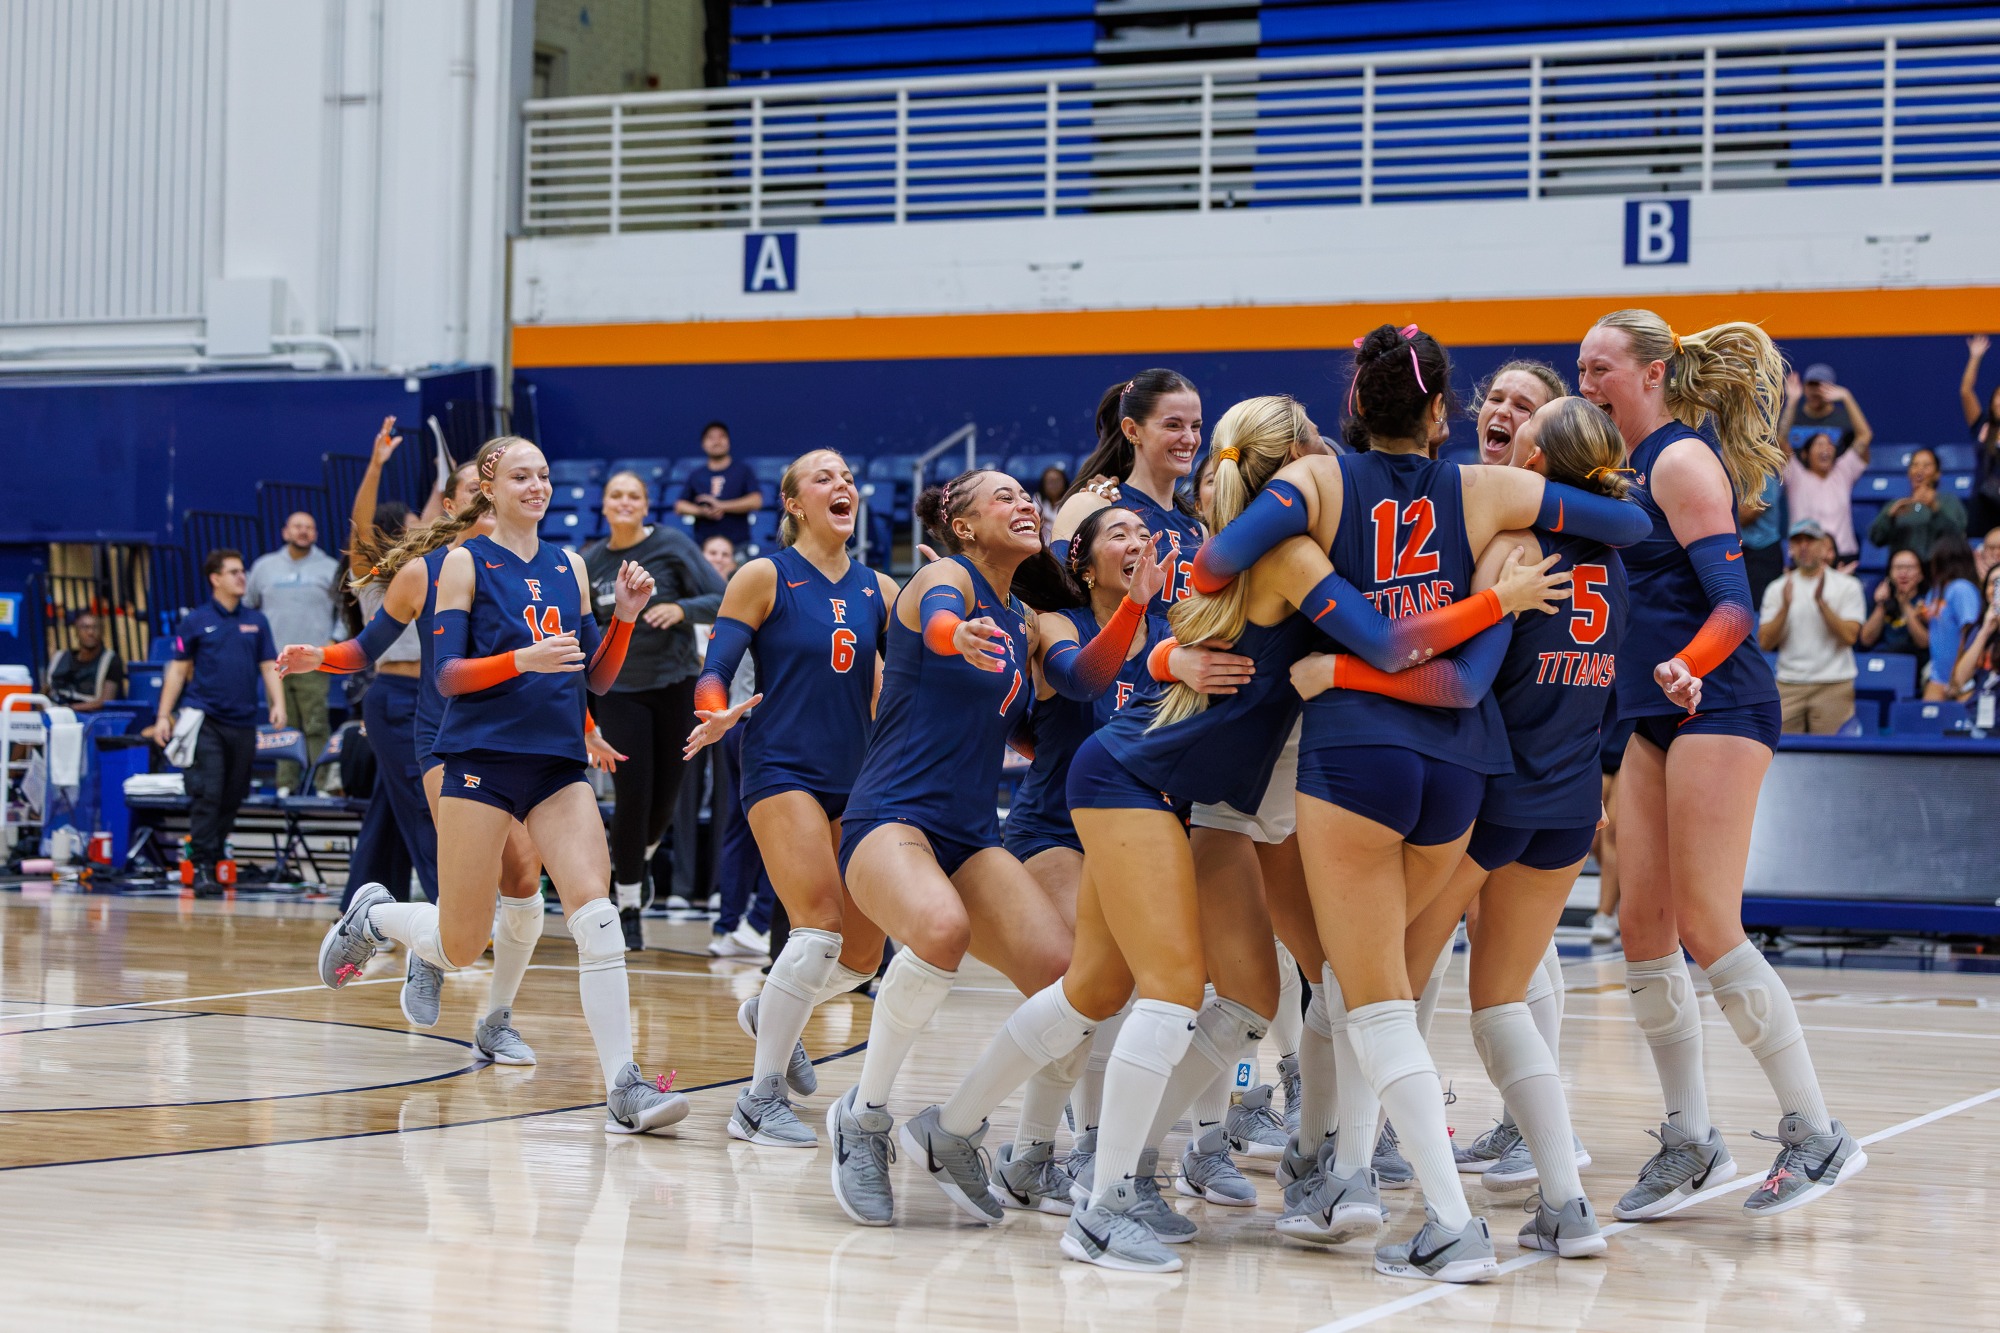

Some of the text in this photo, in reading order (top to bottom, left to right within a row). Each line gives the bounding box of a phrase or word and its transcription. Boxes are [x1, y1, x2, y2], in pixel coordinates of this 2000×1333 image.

[1638, 201, 1675, 263] B
[751, 233, 788, 291] A
[1371, 496, 1439, 583] 12
[524, 578, 543, 601] F
[829, 598, 847, 623] F
[1569, 564, 1610, 644] 5
[523, 605, 563, 643] 14
[831, 628, 857, 673] 6
[1536, 651, 1616, 687] TITANS
[999, 668, 1022, 717] 1
[1114, 680, 1134, 711] F
